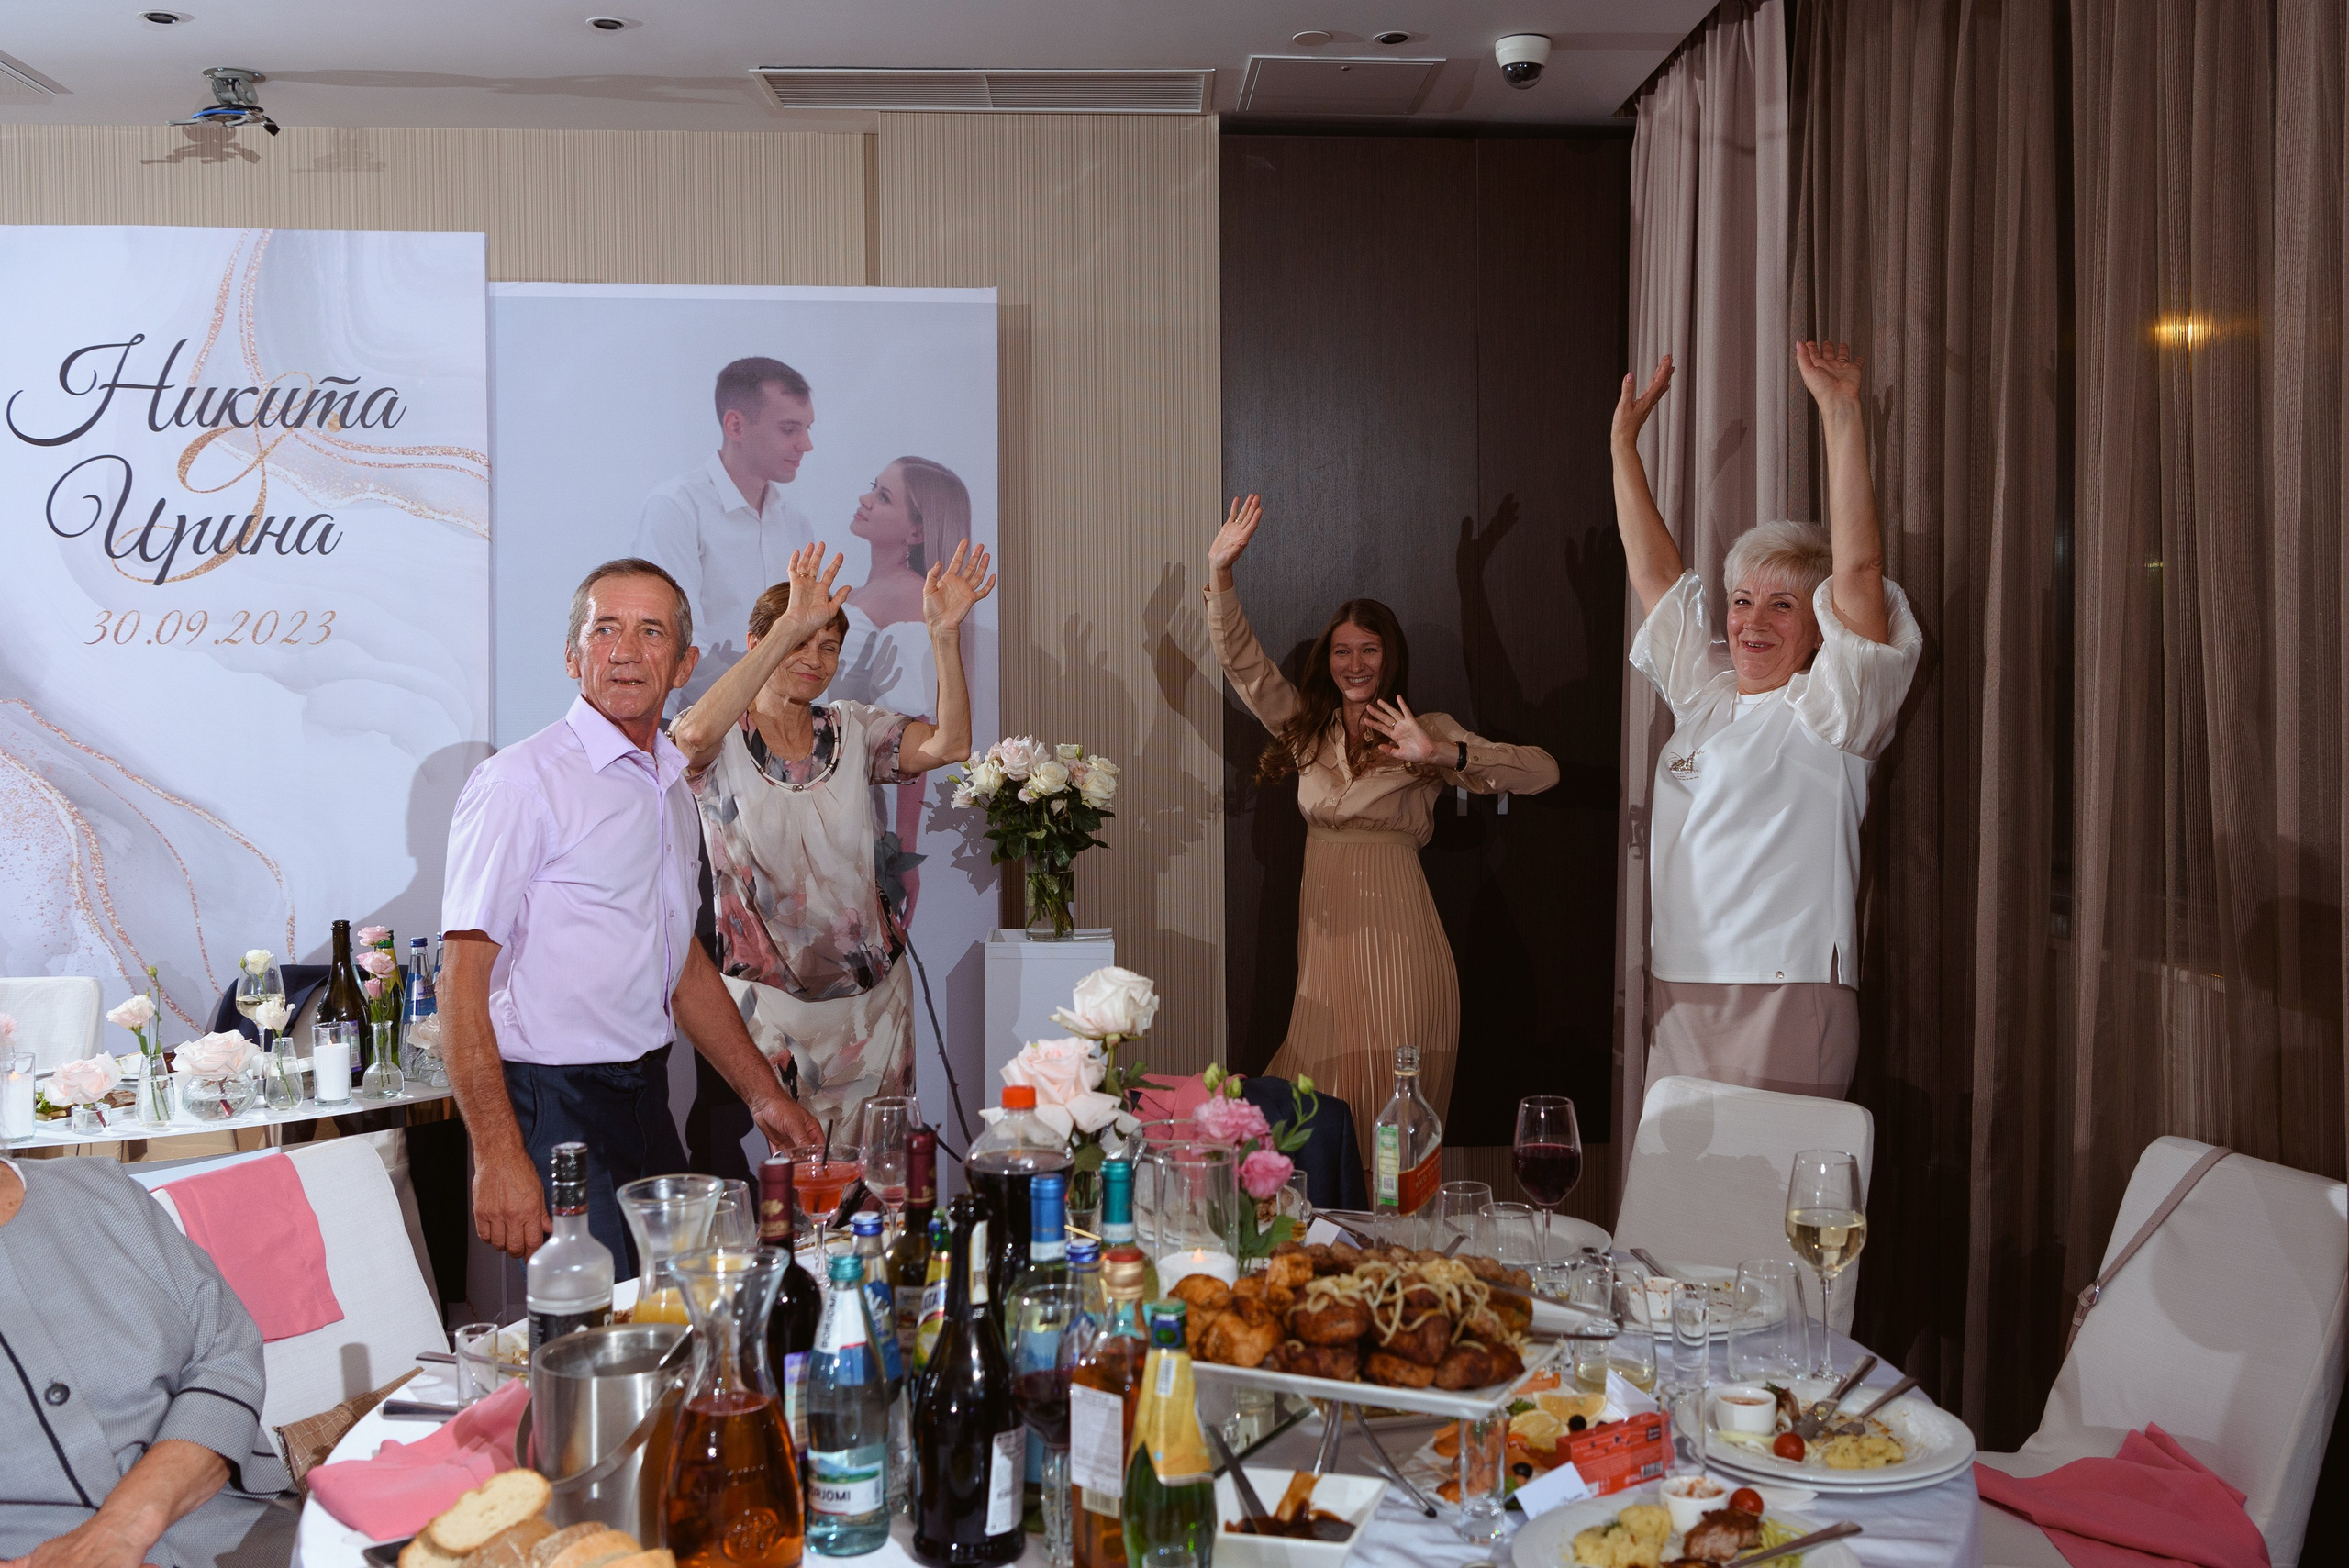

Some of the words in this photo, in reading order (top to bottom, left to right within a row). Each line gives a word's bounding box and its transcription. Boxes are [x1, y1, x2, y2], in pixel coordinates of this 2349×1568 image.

[6, 333, 407, 447] Никита
[46, 454, 344, 585] Ирина
[83, 609, 338, 646] 30.09.2023
